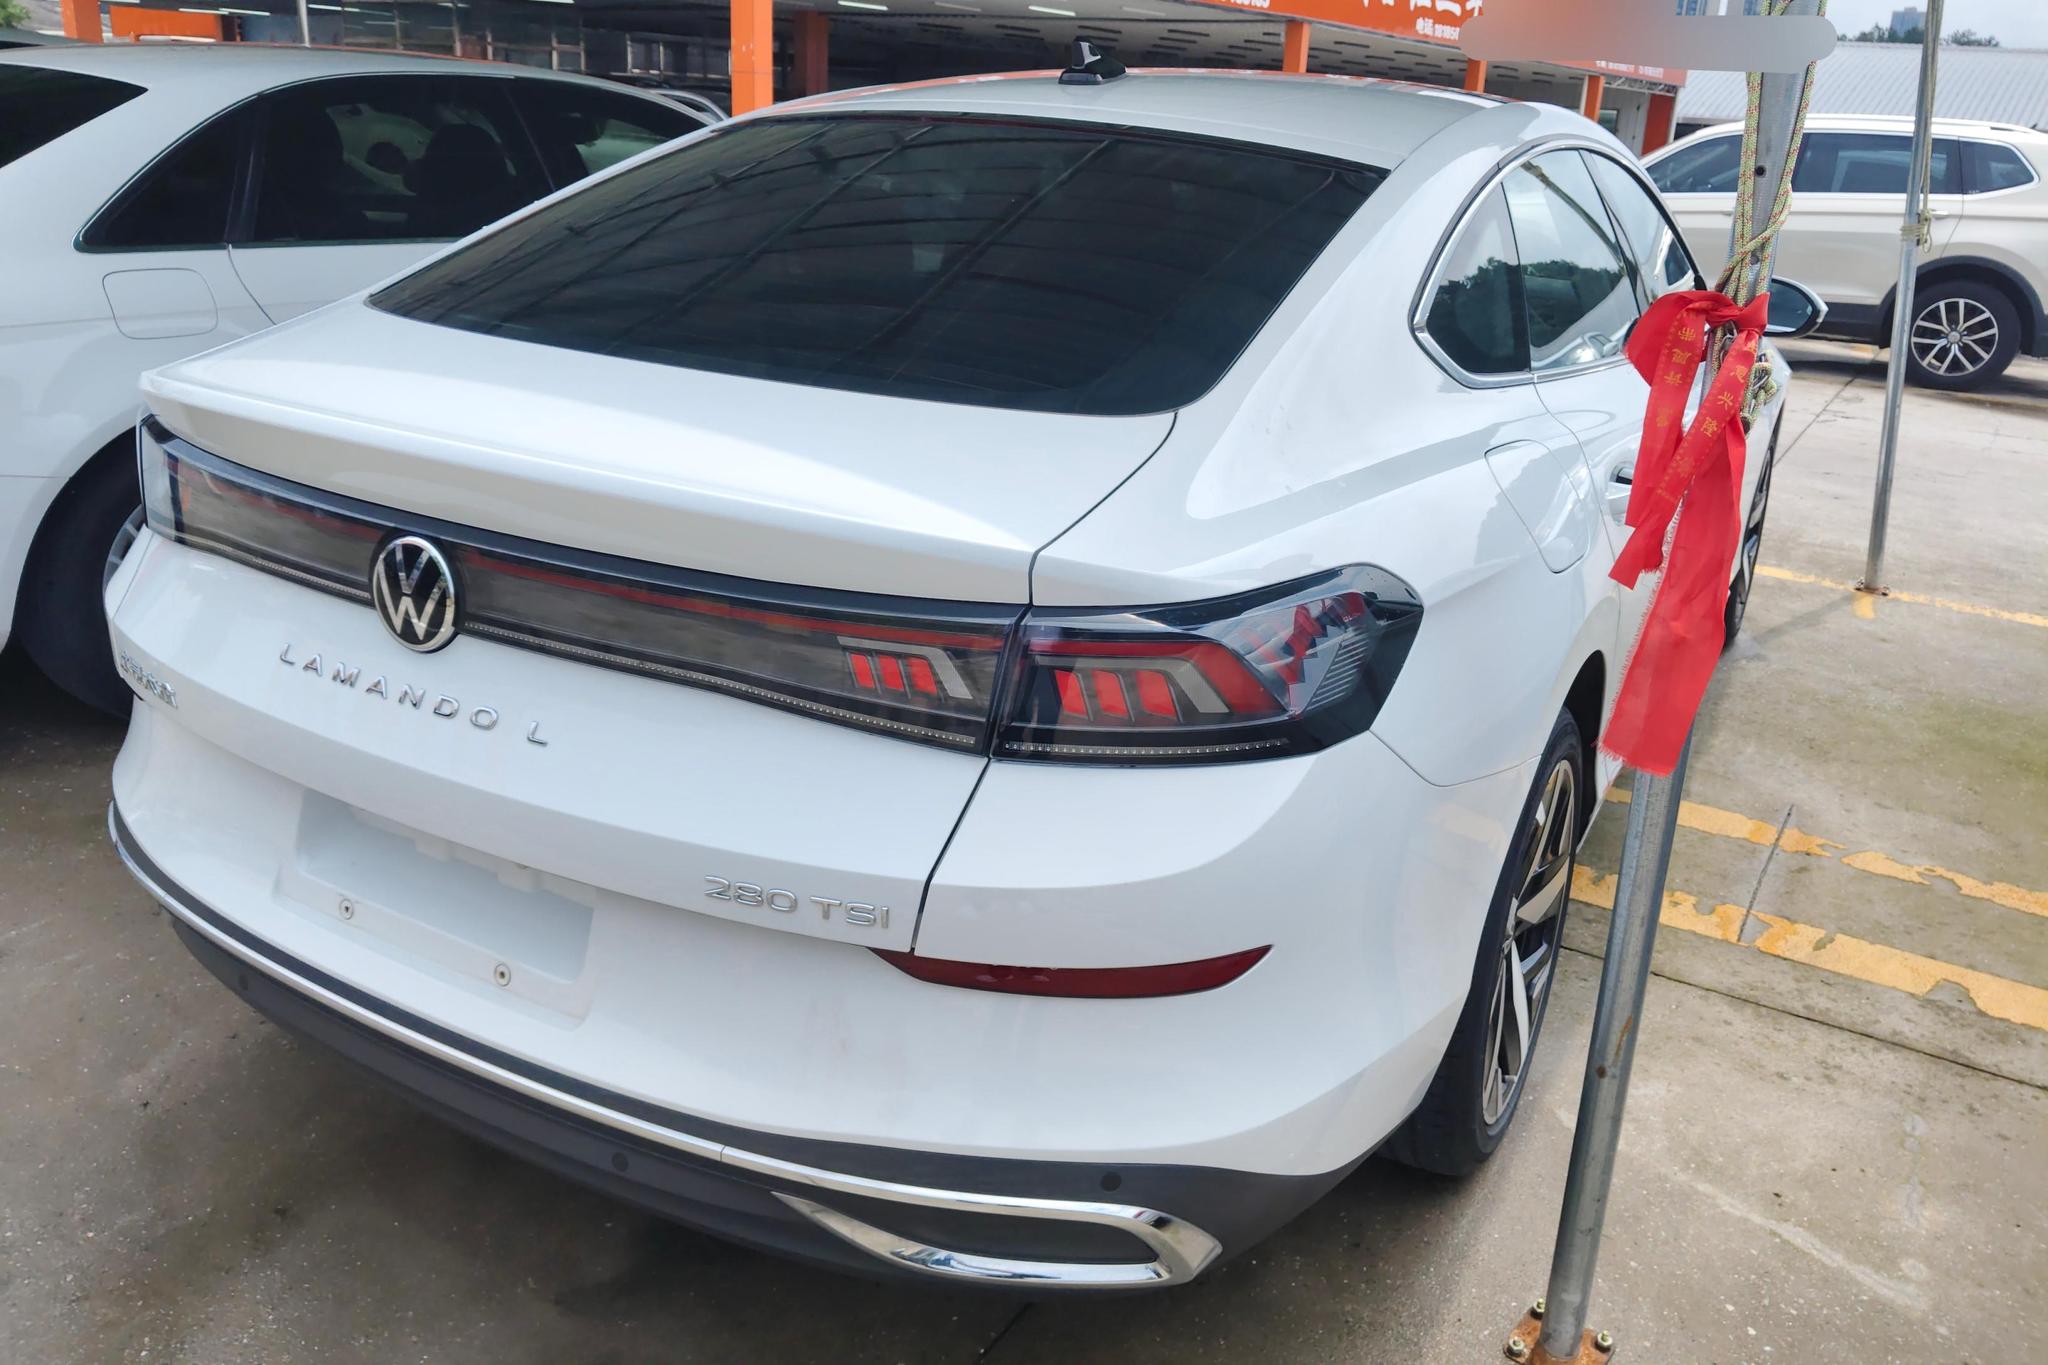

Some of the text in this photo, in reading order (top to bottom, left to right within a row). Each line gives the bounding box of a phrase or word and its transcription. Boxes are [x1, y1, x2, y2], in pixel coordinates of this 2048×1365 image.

[279, 642, 549, 747] LAMANDO L
[704, 874, 889, 929] 280 TSI
